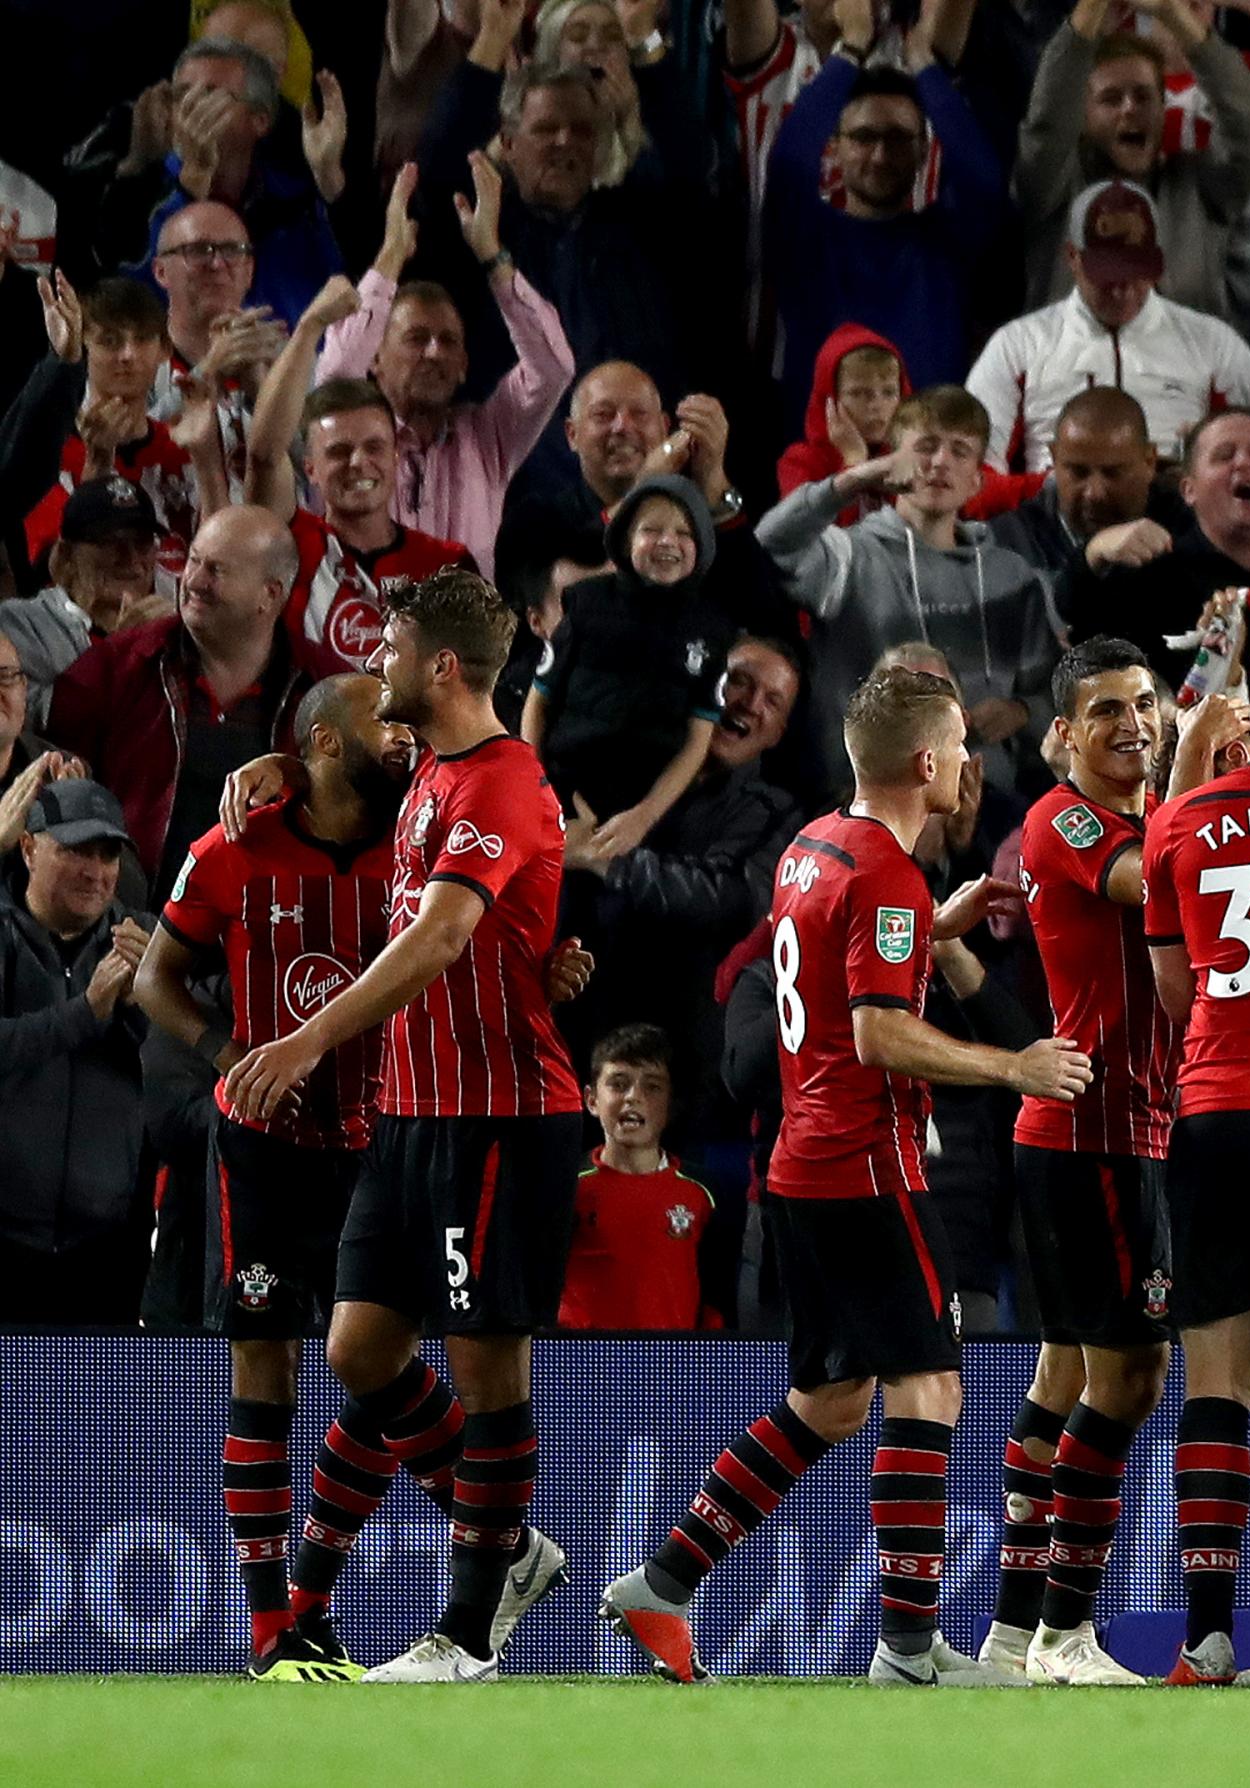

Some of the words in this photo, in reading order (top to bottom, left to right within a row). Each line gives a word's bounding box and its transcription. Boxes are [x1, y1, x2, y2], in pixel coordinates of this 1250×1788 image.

[292, 964, 345, 1010] Virgin
[773, 916, 806, 1054] 8
[445, 1226, 469, 1288] 5
